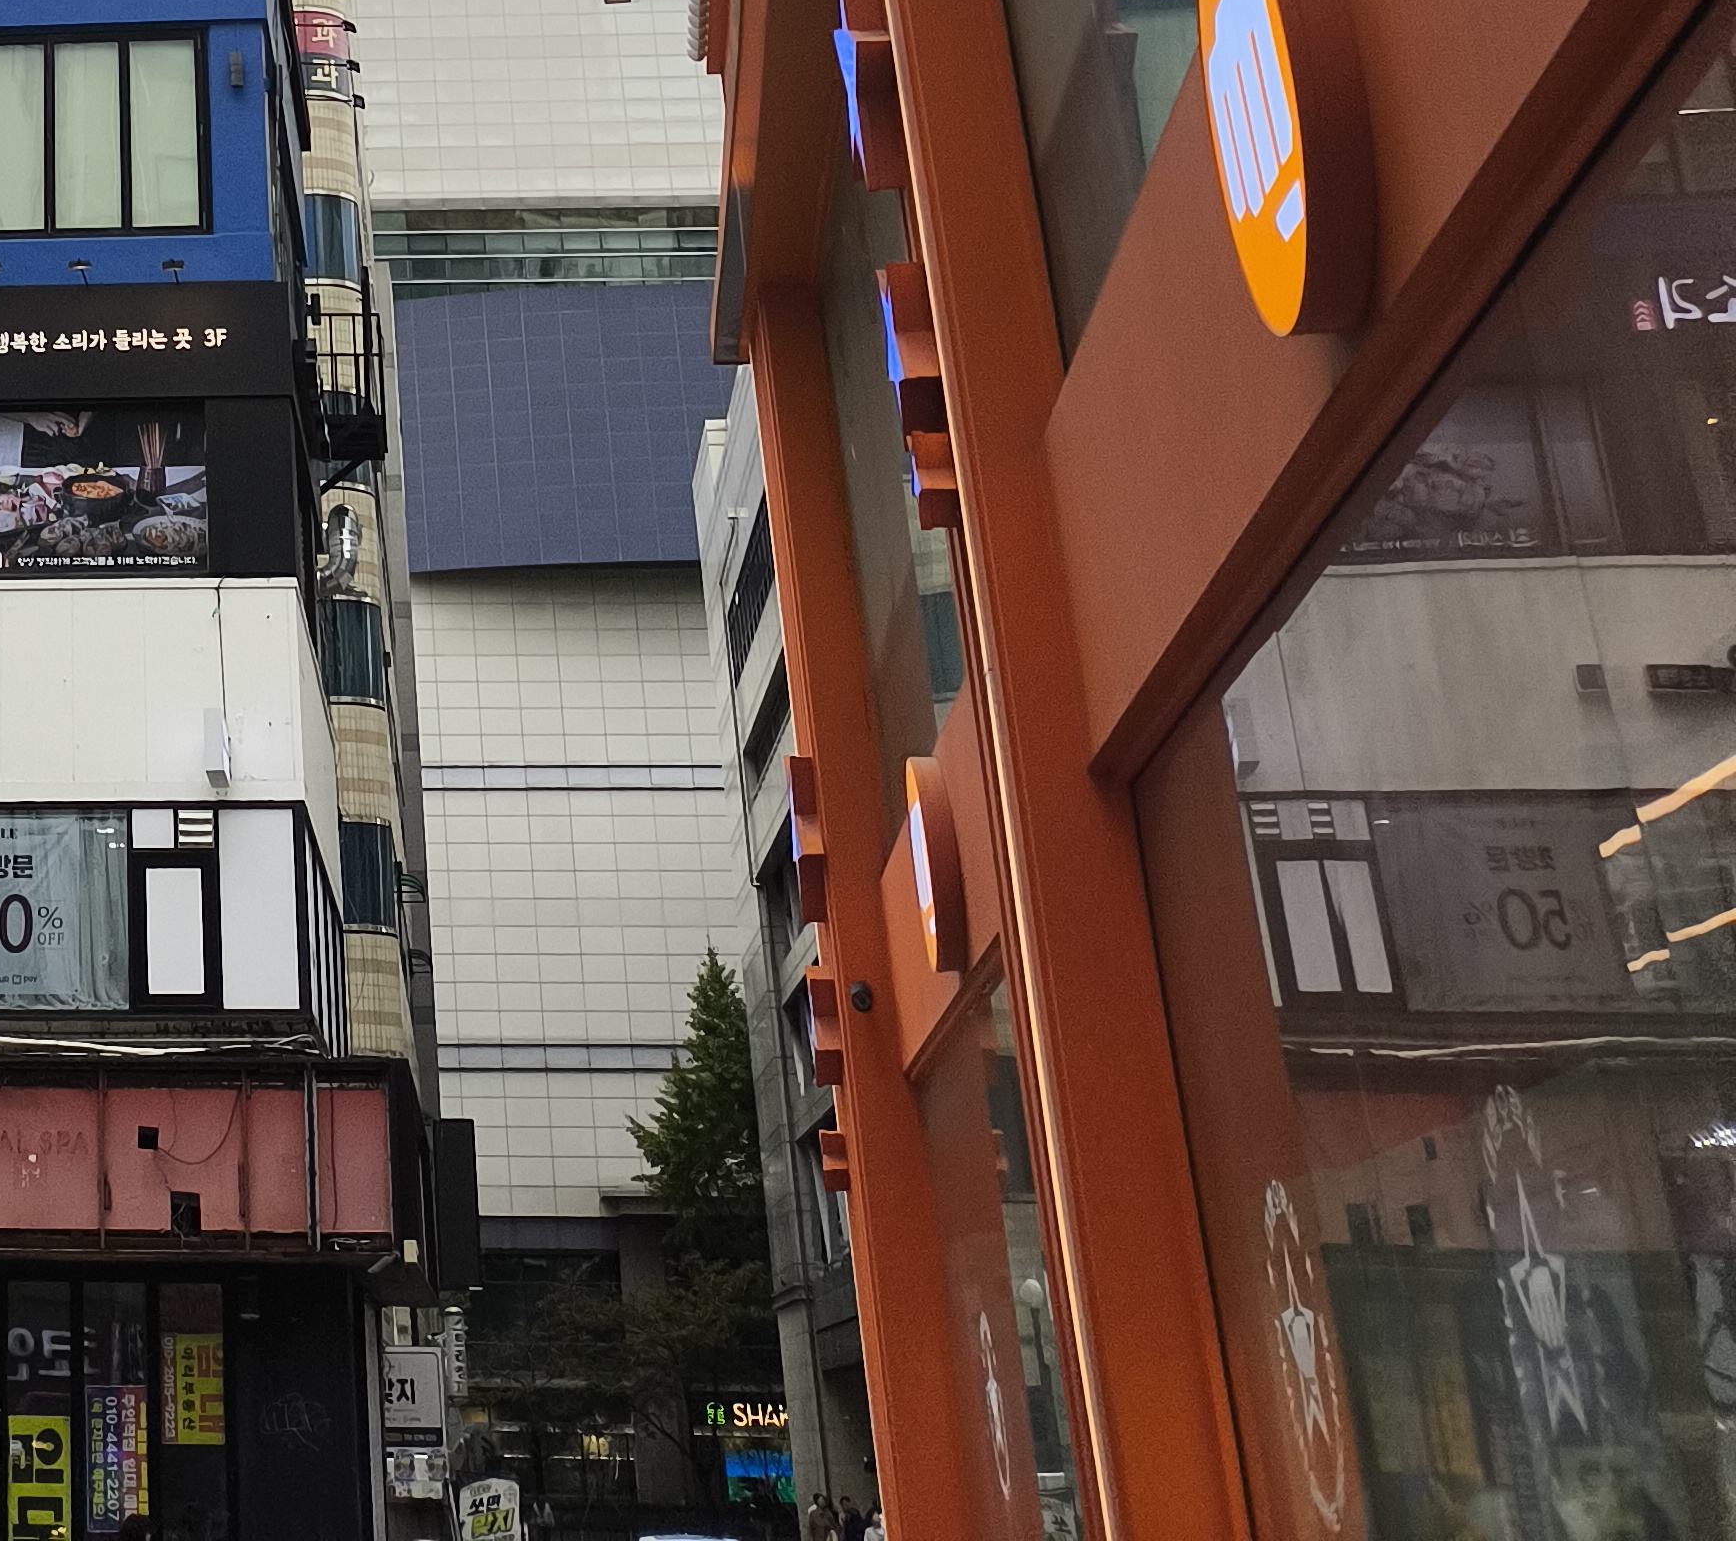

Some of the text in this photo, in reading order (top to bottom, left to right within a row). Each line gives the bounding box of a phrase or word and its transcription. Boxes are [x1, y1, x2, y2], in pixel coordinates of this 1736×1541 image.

[52, 329, 106, 352] 소리가
[112, 328, 168, 351] 들리는
[172, 328, 193, 351] 곳
[203, 328, 228, 348] 3F
[105, 1396, 120, 1522] 010-4441-2207
